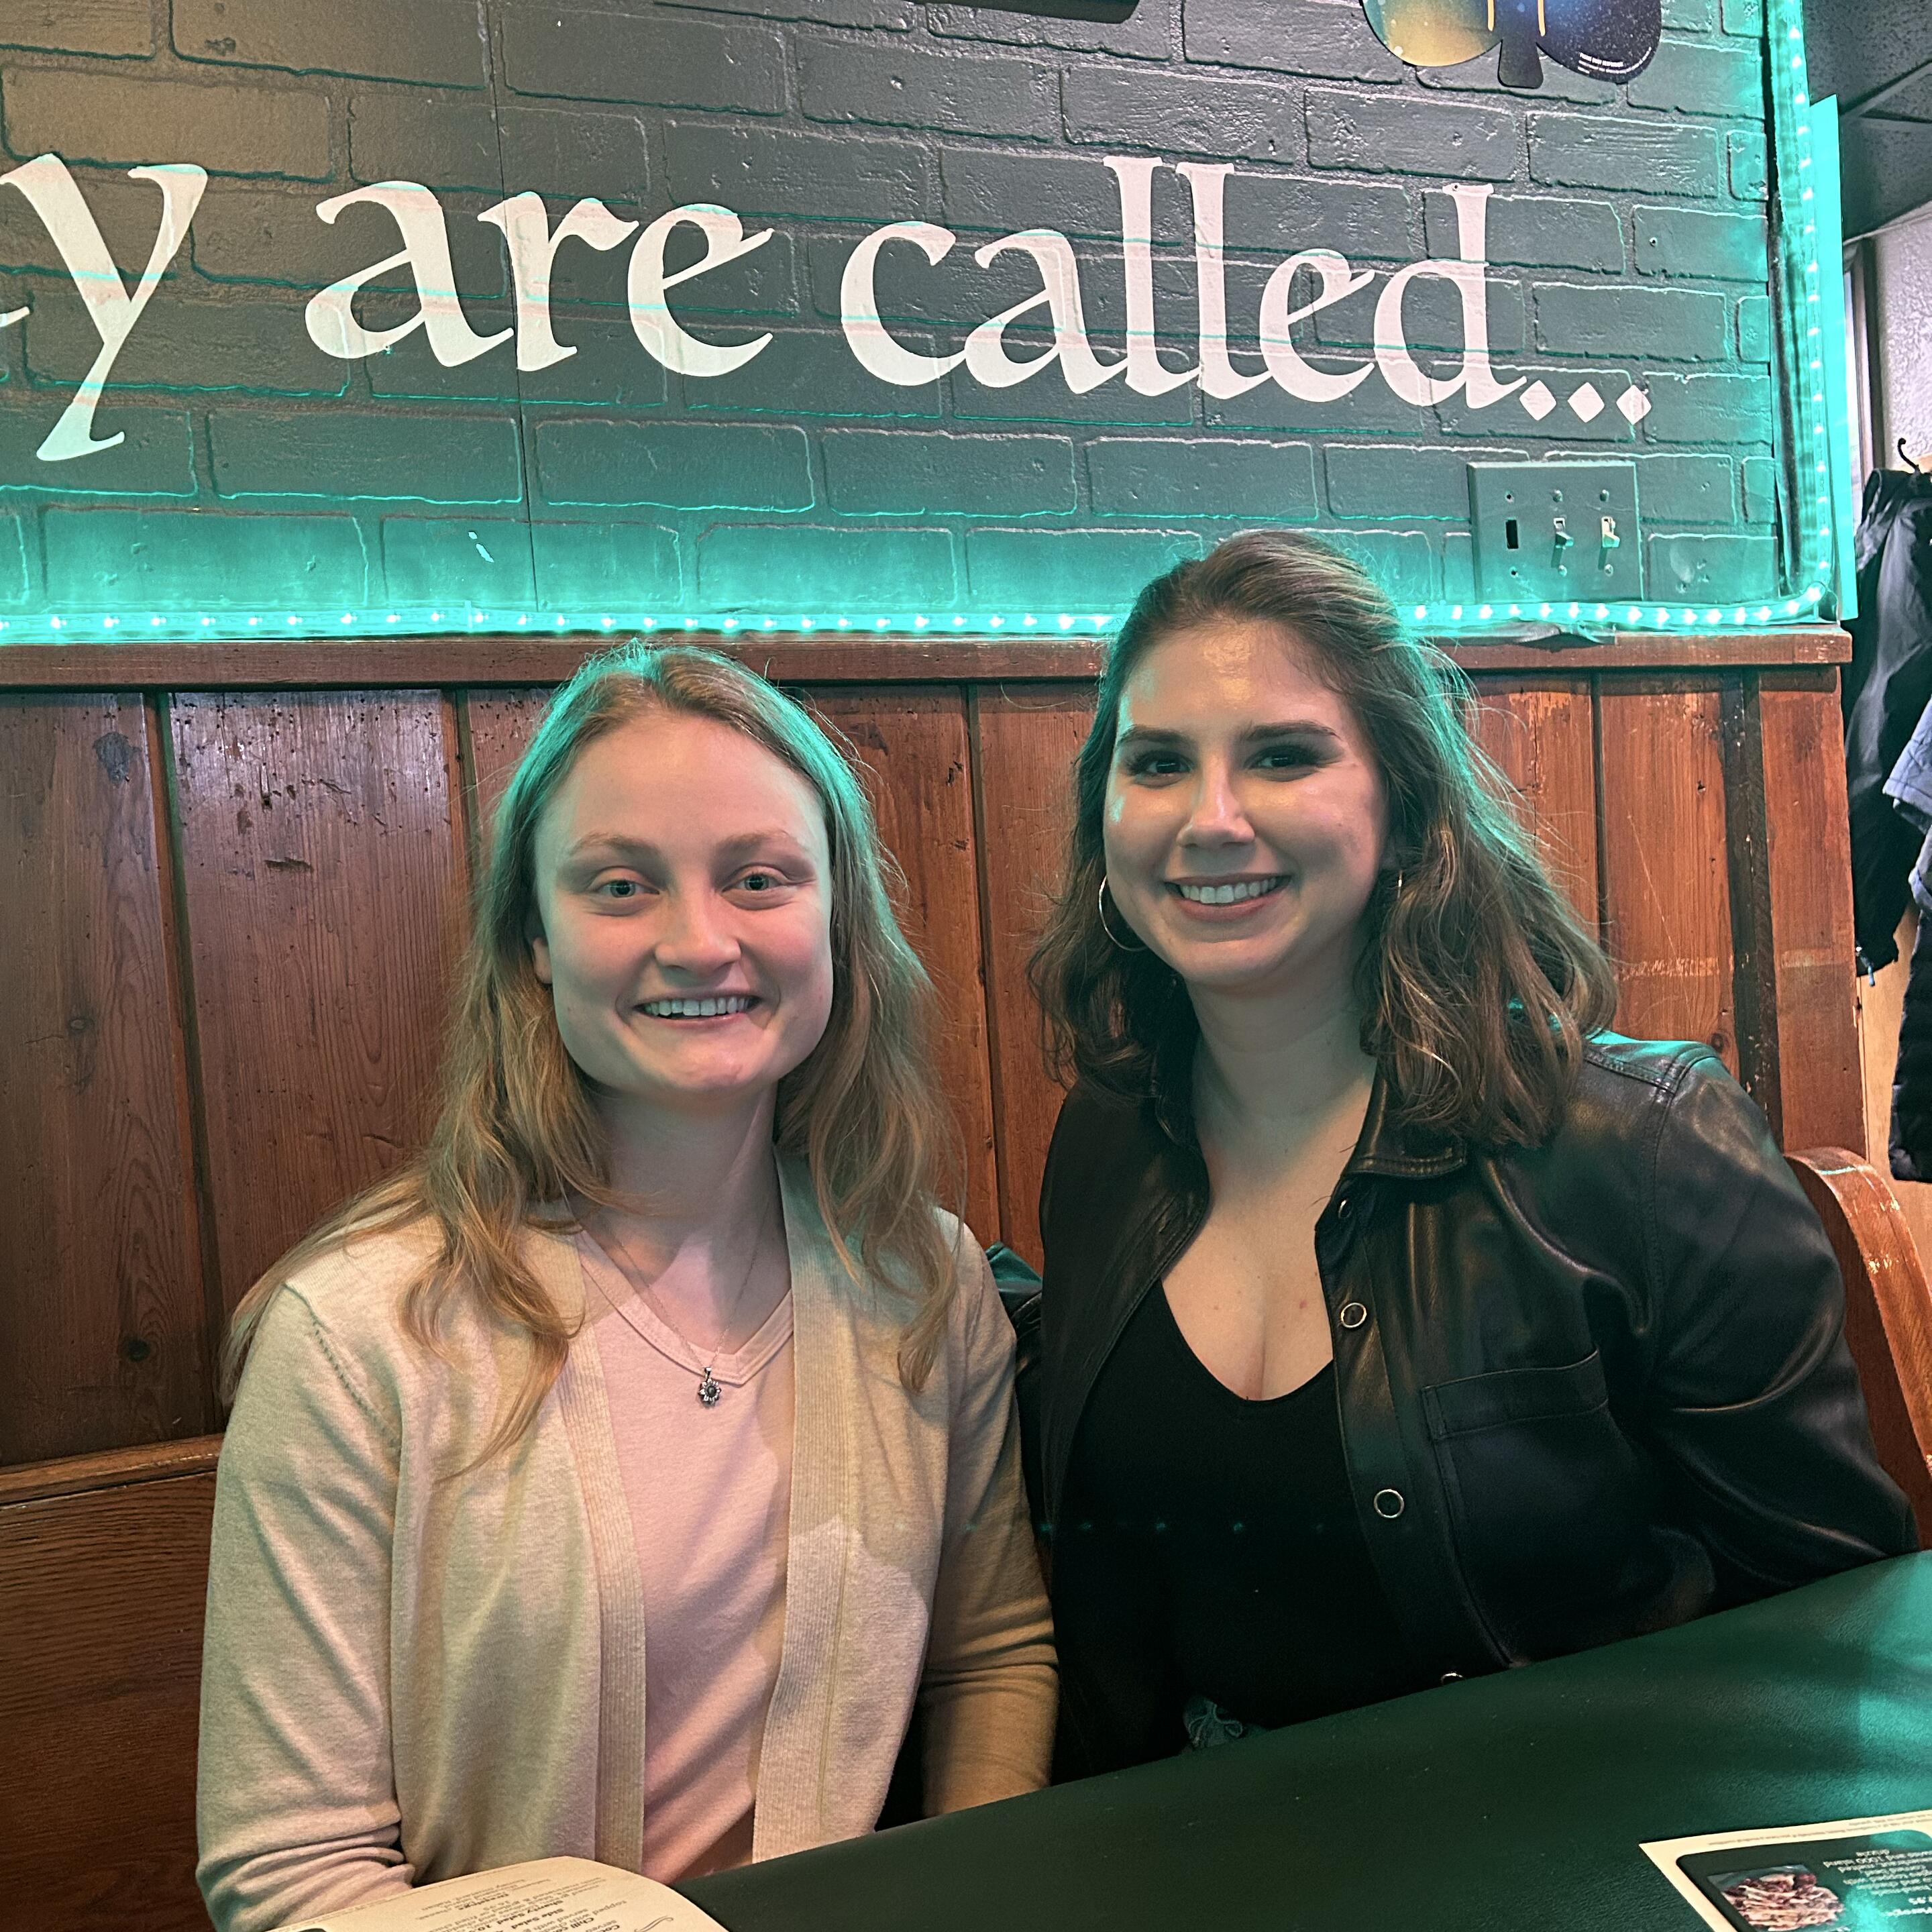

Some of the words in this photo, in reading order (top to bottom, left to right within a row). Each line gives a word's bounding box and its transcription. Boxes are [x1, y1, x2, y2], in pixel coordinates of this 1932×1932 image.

[0, 152, 208, 462] y
[304, 180, 775, 378] are
[840, 154, 1652, 425] called...
[497, 1913, 525, 1926] Salad
[542, 1908, 564, 1919] Side
[511, 1917, 539, 1931] Salad
